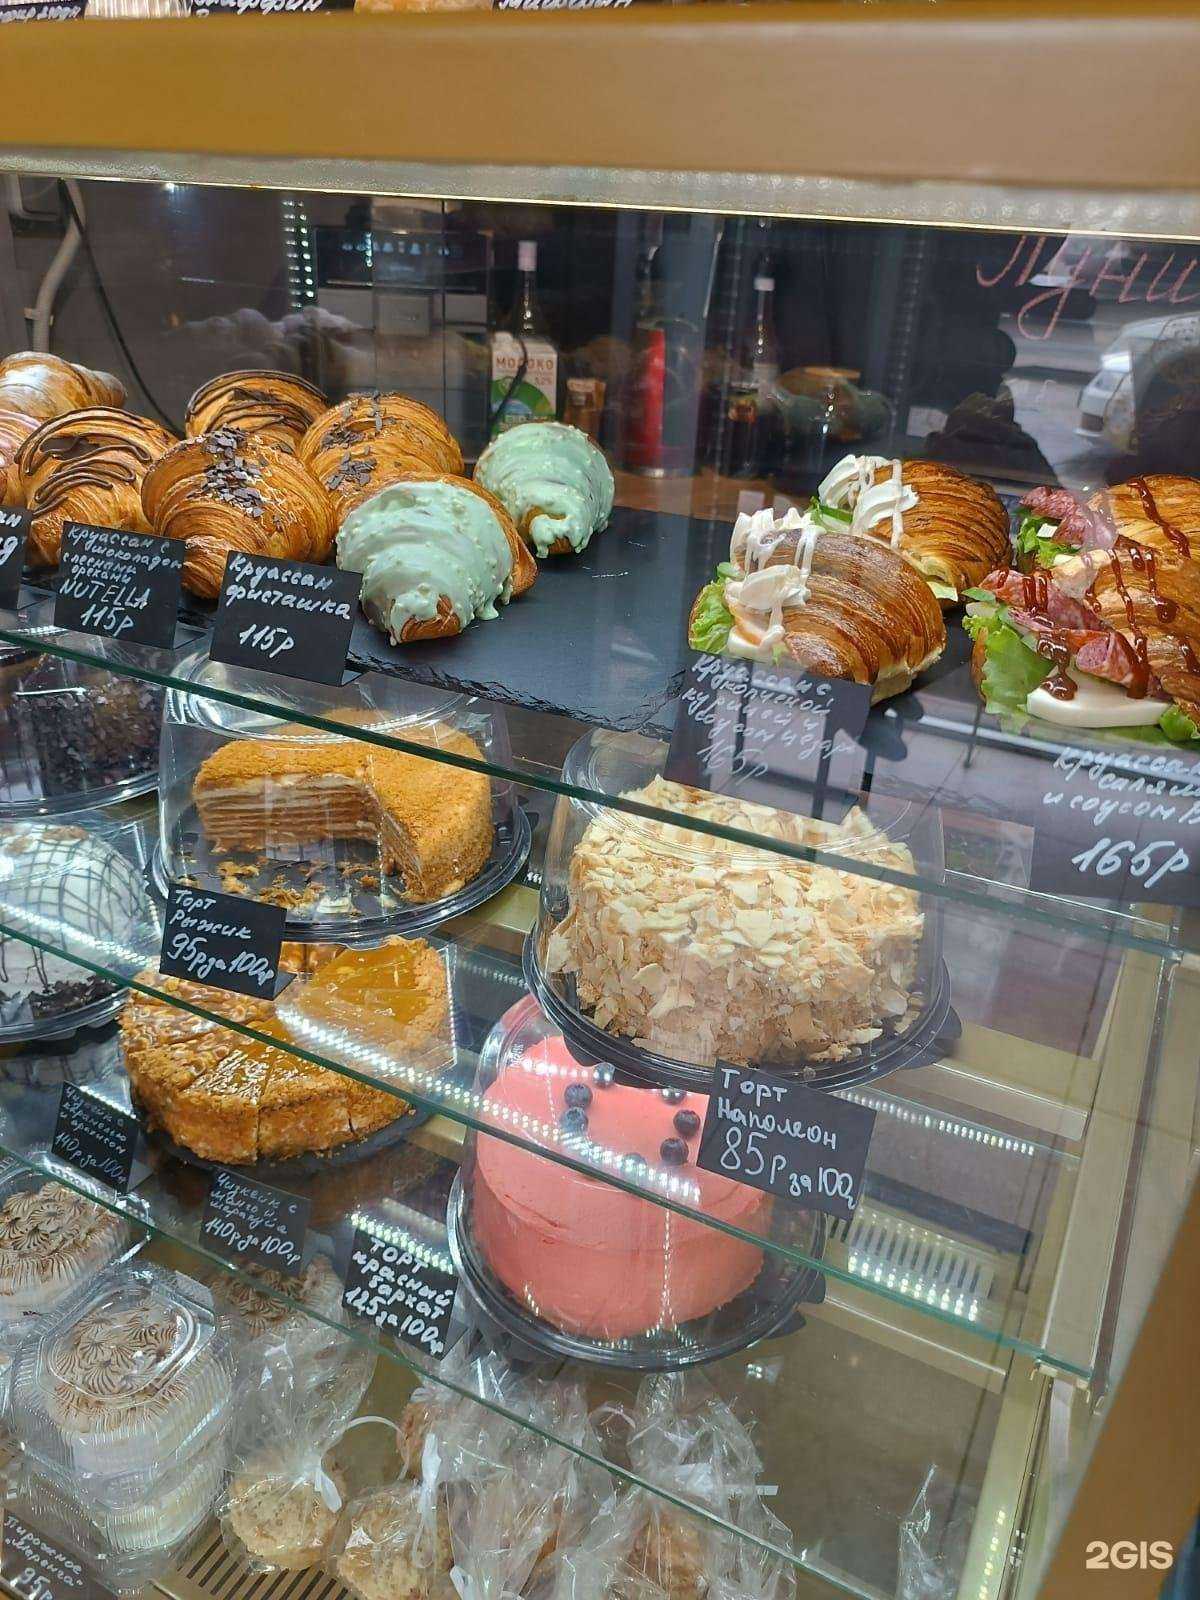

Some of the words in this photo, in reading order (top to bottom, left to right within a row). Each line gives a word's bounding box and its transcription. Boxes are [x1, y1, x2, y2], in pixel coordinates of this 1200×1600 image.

[71, 564, 132, 584] орехами
[229, 553, 333, 590] Круассан
[59, 578, 151, 610] NUTELLA
[226, 584, 351, 620] фисташка
[1070, 795, 1176, 827] соусом
[175, 889, 217, 912] Торт
[720, 1068, 789, 1107] Торт
[717, 1096, 837, 1150] Наполеон
